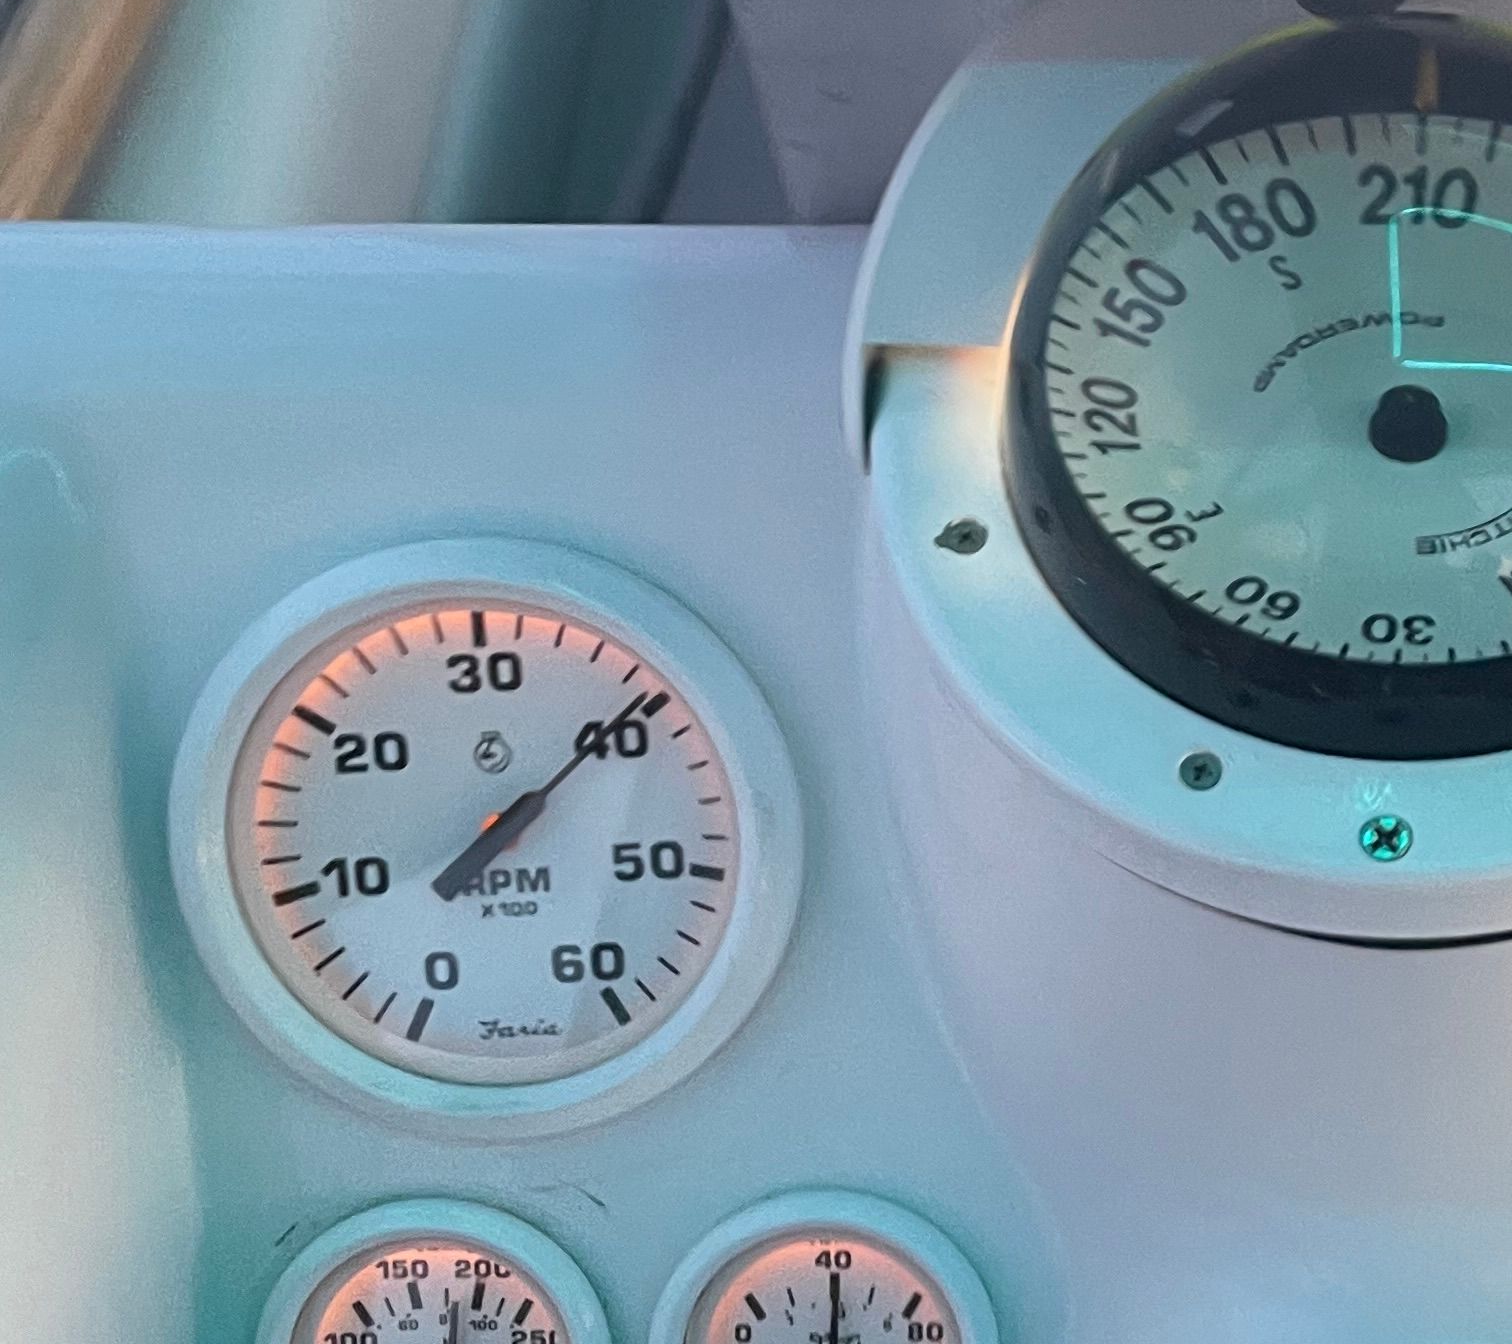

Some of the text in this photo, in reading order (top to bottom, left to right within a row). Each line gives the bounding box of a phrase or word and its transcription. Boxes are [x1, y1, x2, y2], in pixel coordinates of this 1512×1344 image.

[1358, 164, 1479, 229] 210
[1191, 176, 1318, 264] 180
[1268, 255, 1304, 291] S
[1093, 257, 1188, 349] 150
[1080, 376, 1143, 456] 120
[1123, 496, 1199, 553] 90
[1224, 575, 1304, 623] 60
[1360, 611, 1439, 647] 30
[447, 651, 523, 693] 30
[333, 732, 409, 774] 20
[574, 719, 649, 759] 40
[320, 855, 390, 898] 10
[612, 840, 685, 882] 50
[424, 951, 460, 990] 0
[551, 941, 626, 983] 60
[375, 1259, 430, 1279] 150
[454, 1259, 511, 1279] 200
[814, 1250, 852, 1270] 40
[734, 1323, 753, 1344] 0
